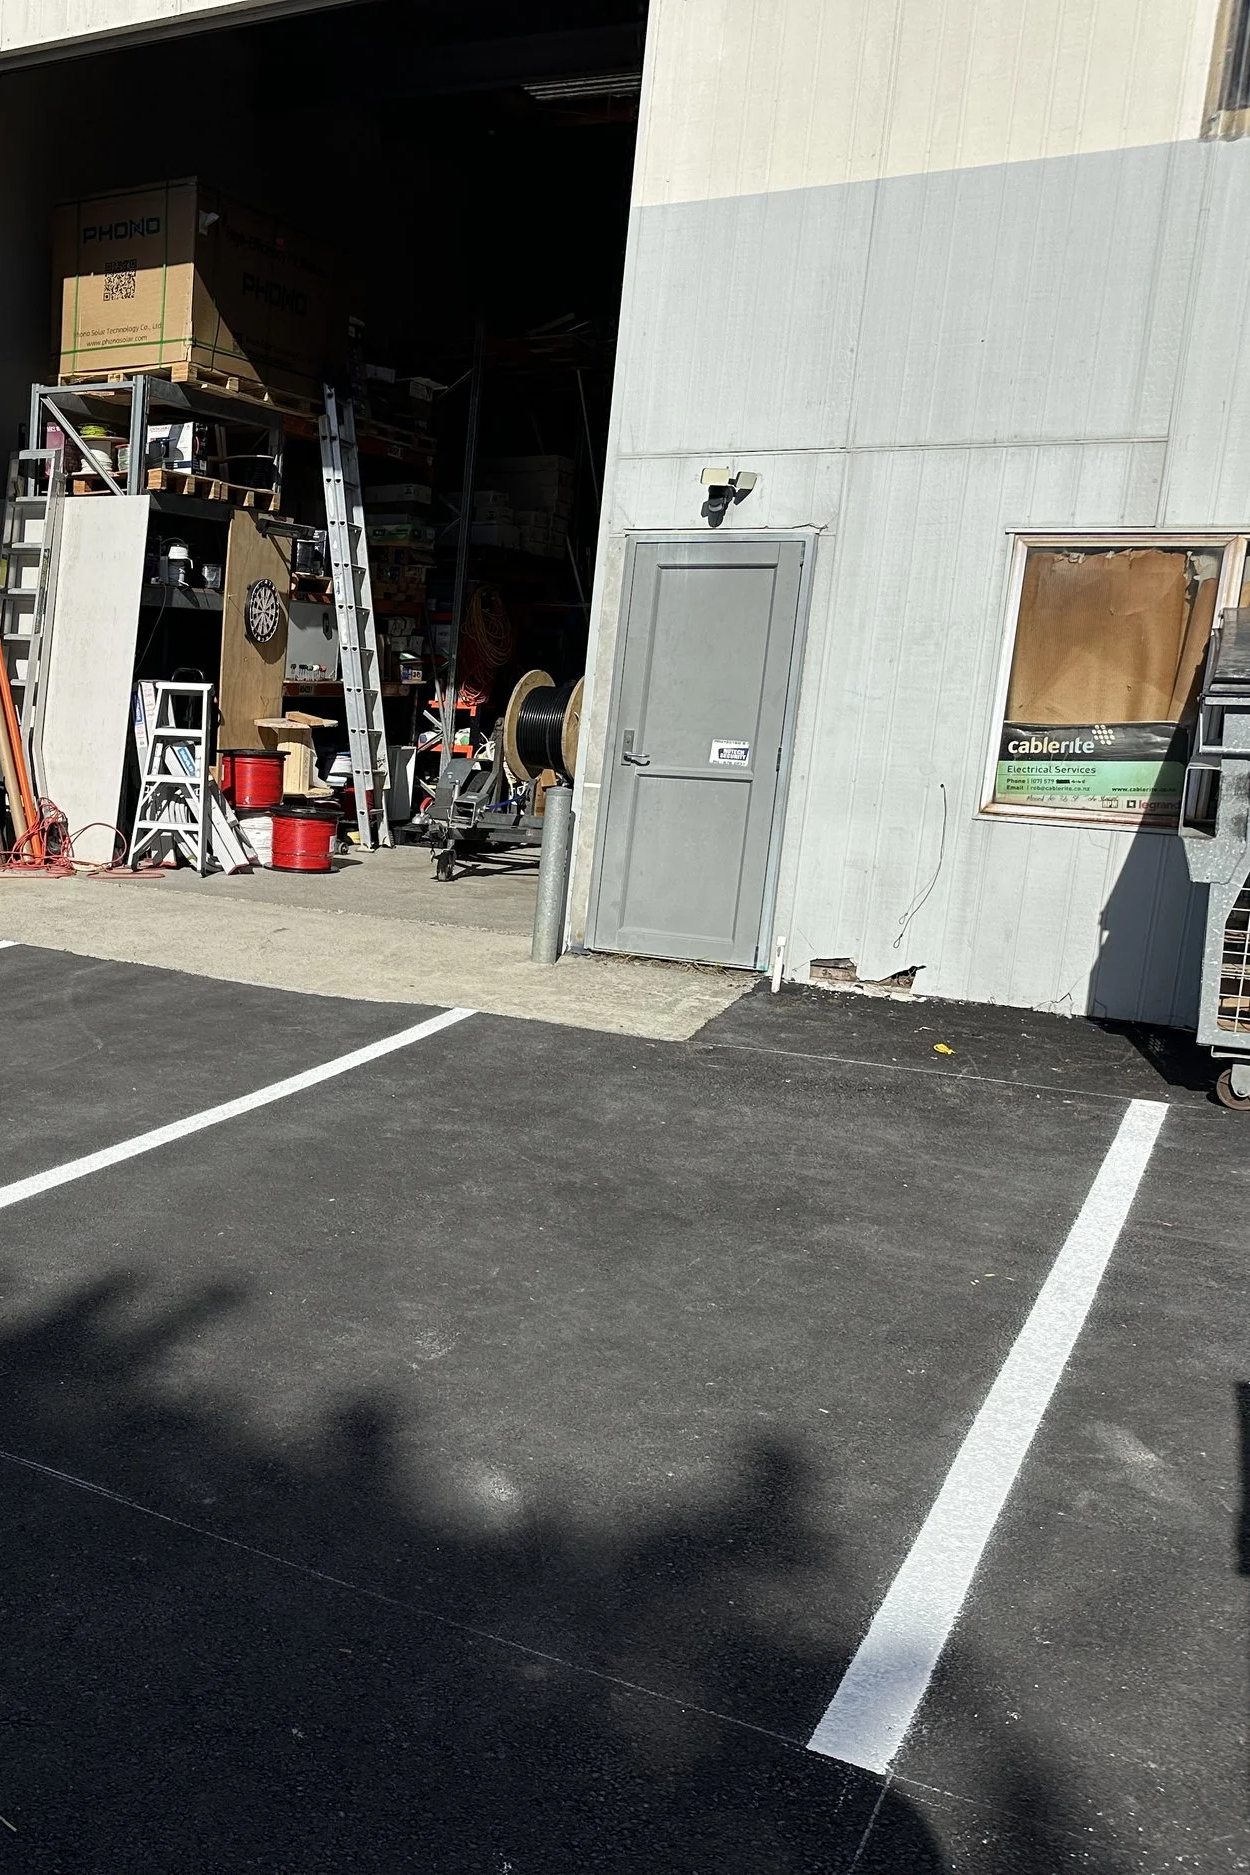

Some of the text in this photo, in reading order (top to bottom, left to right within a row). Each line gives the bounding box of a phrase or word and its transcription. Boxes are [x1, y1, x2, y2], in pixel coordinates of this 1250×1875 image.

[83, 216, 161, 245] PHONO
[75, 329, 91, 338] hono
[106, 325, 139, 335] Technology
[1007, 736, 1095, 754] cablerite
[1007, 765, 1097, 774] Electrical Services
